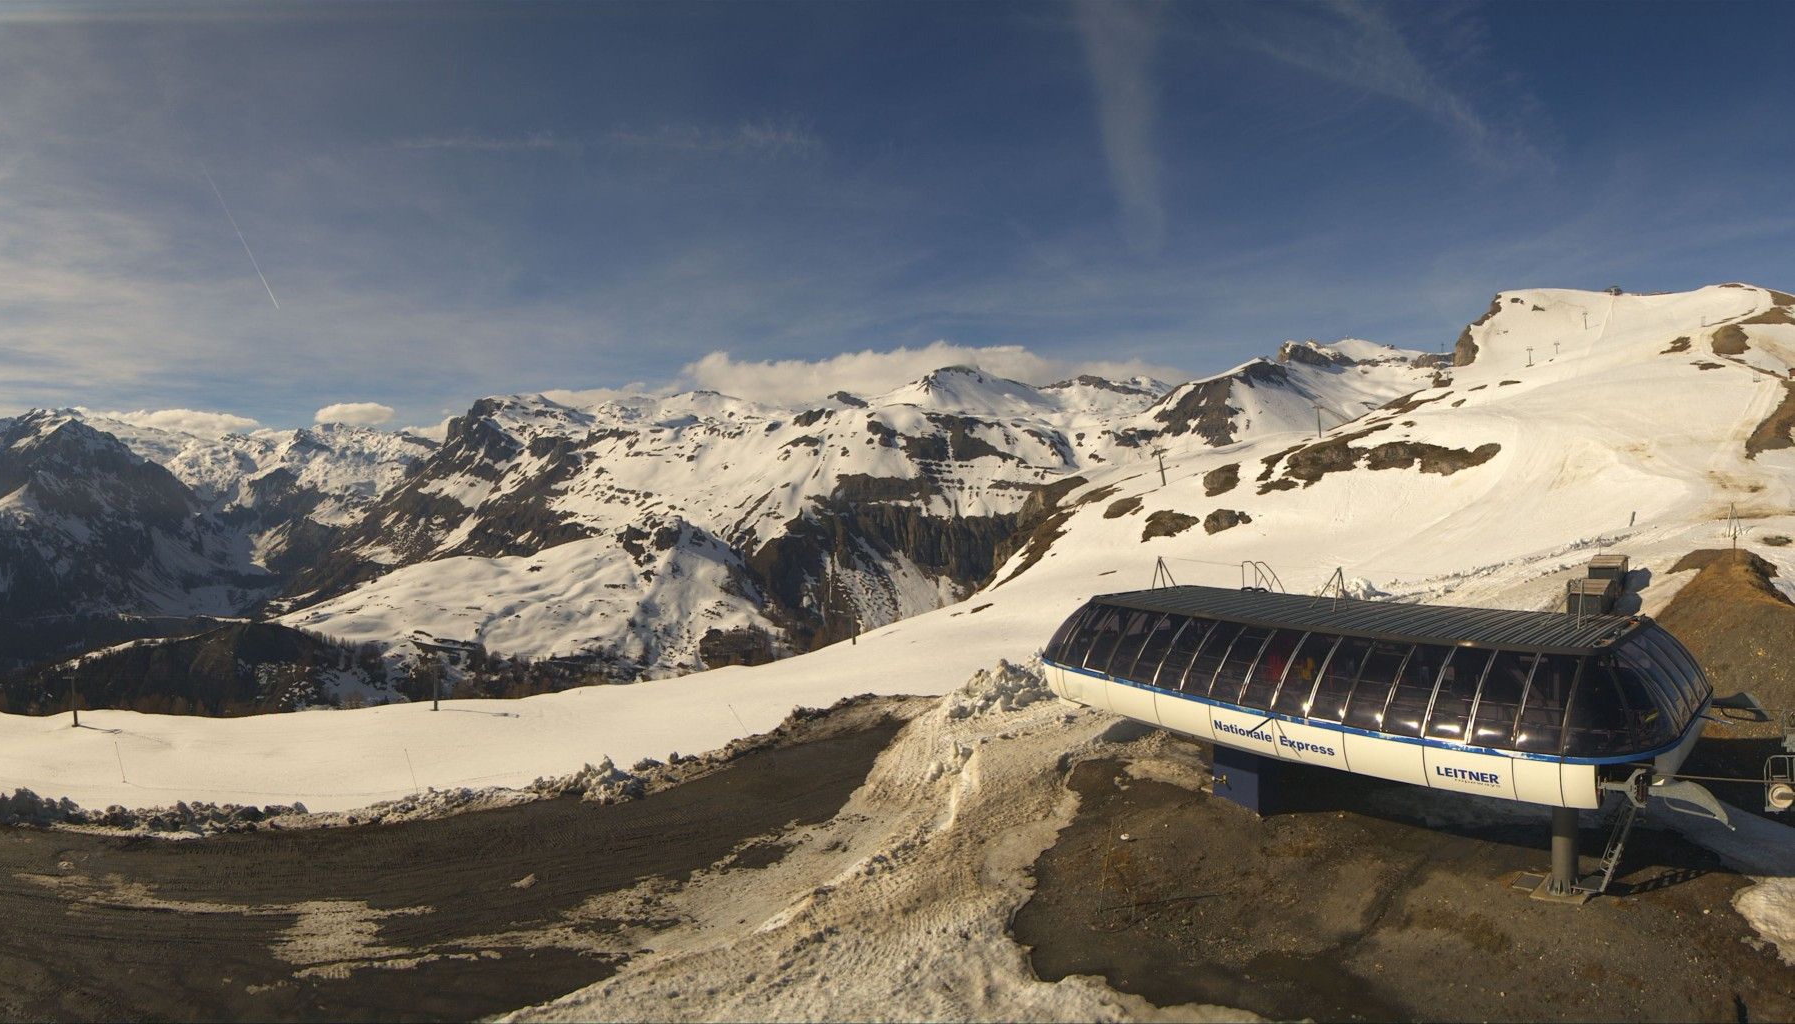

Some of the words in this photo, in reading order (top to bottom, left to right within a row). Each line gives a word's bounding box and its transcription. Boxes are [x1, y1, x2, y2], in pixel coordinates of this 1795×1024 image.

[1213, 719, 1273, 743] Nationale
[1279, 735, 1335, 756] Express
[1436, 765, 1500, 784] LEITNER
